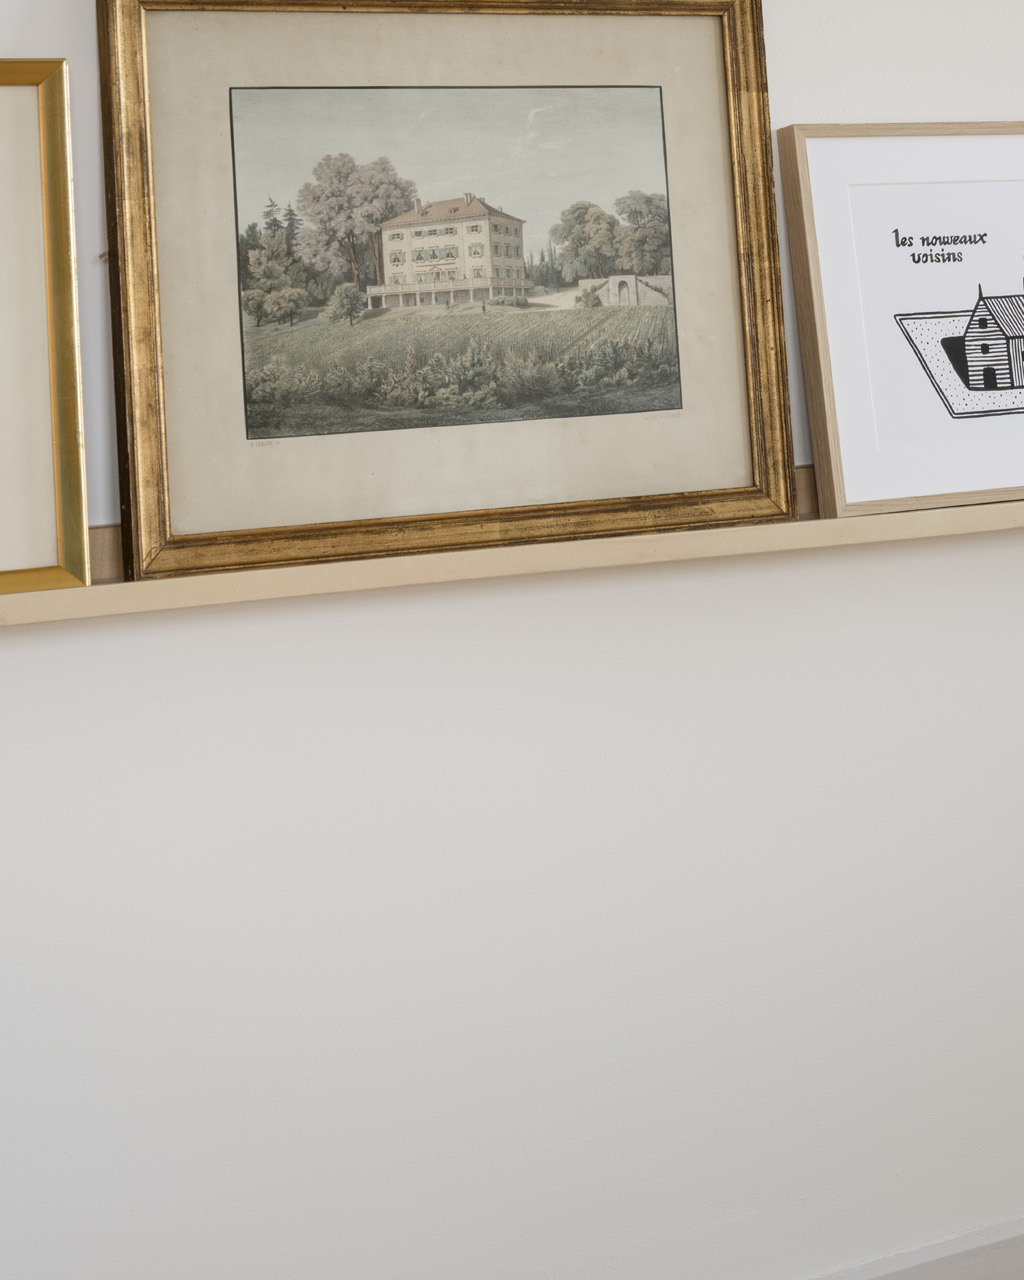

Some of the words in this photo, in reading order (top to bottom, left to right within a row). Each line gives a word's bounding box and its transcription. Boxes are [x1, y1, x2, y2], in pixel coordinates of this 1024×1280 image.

[891, 228, 914, 248] les
[919, 232, 988, 247] nouveaux
[910, 248, 963, 264] voisins
